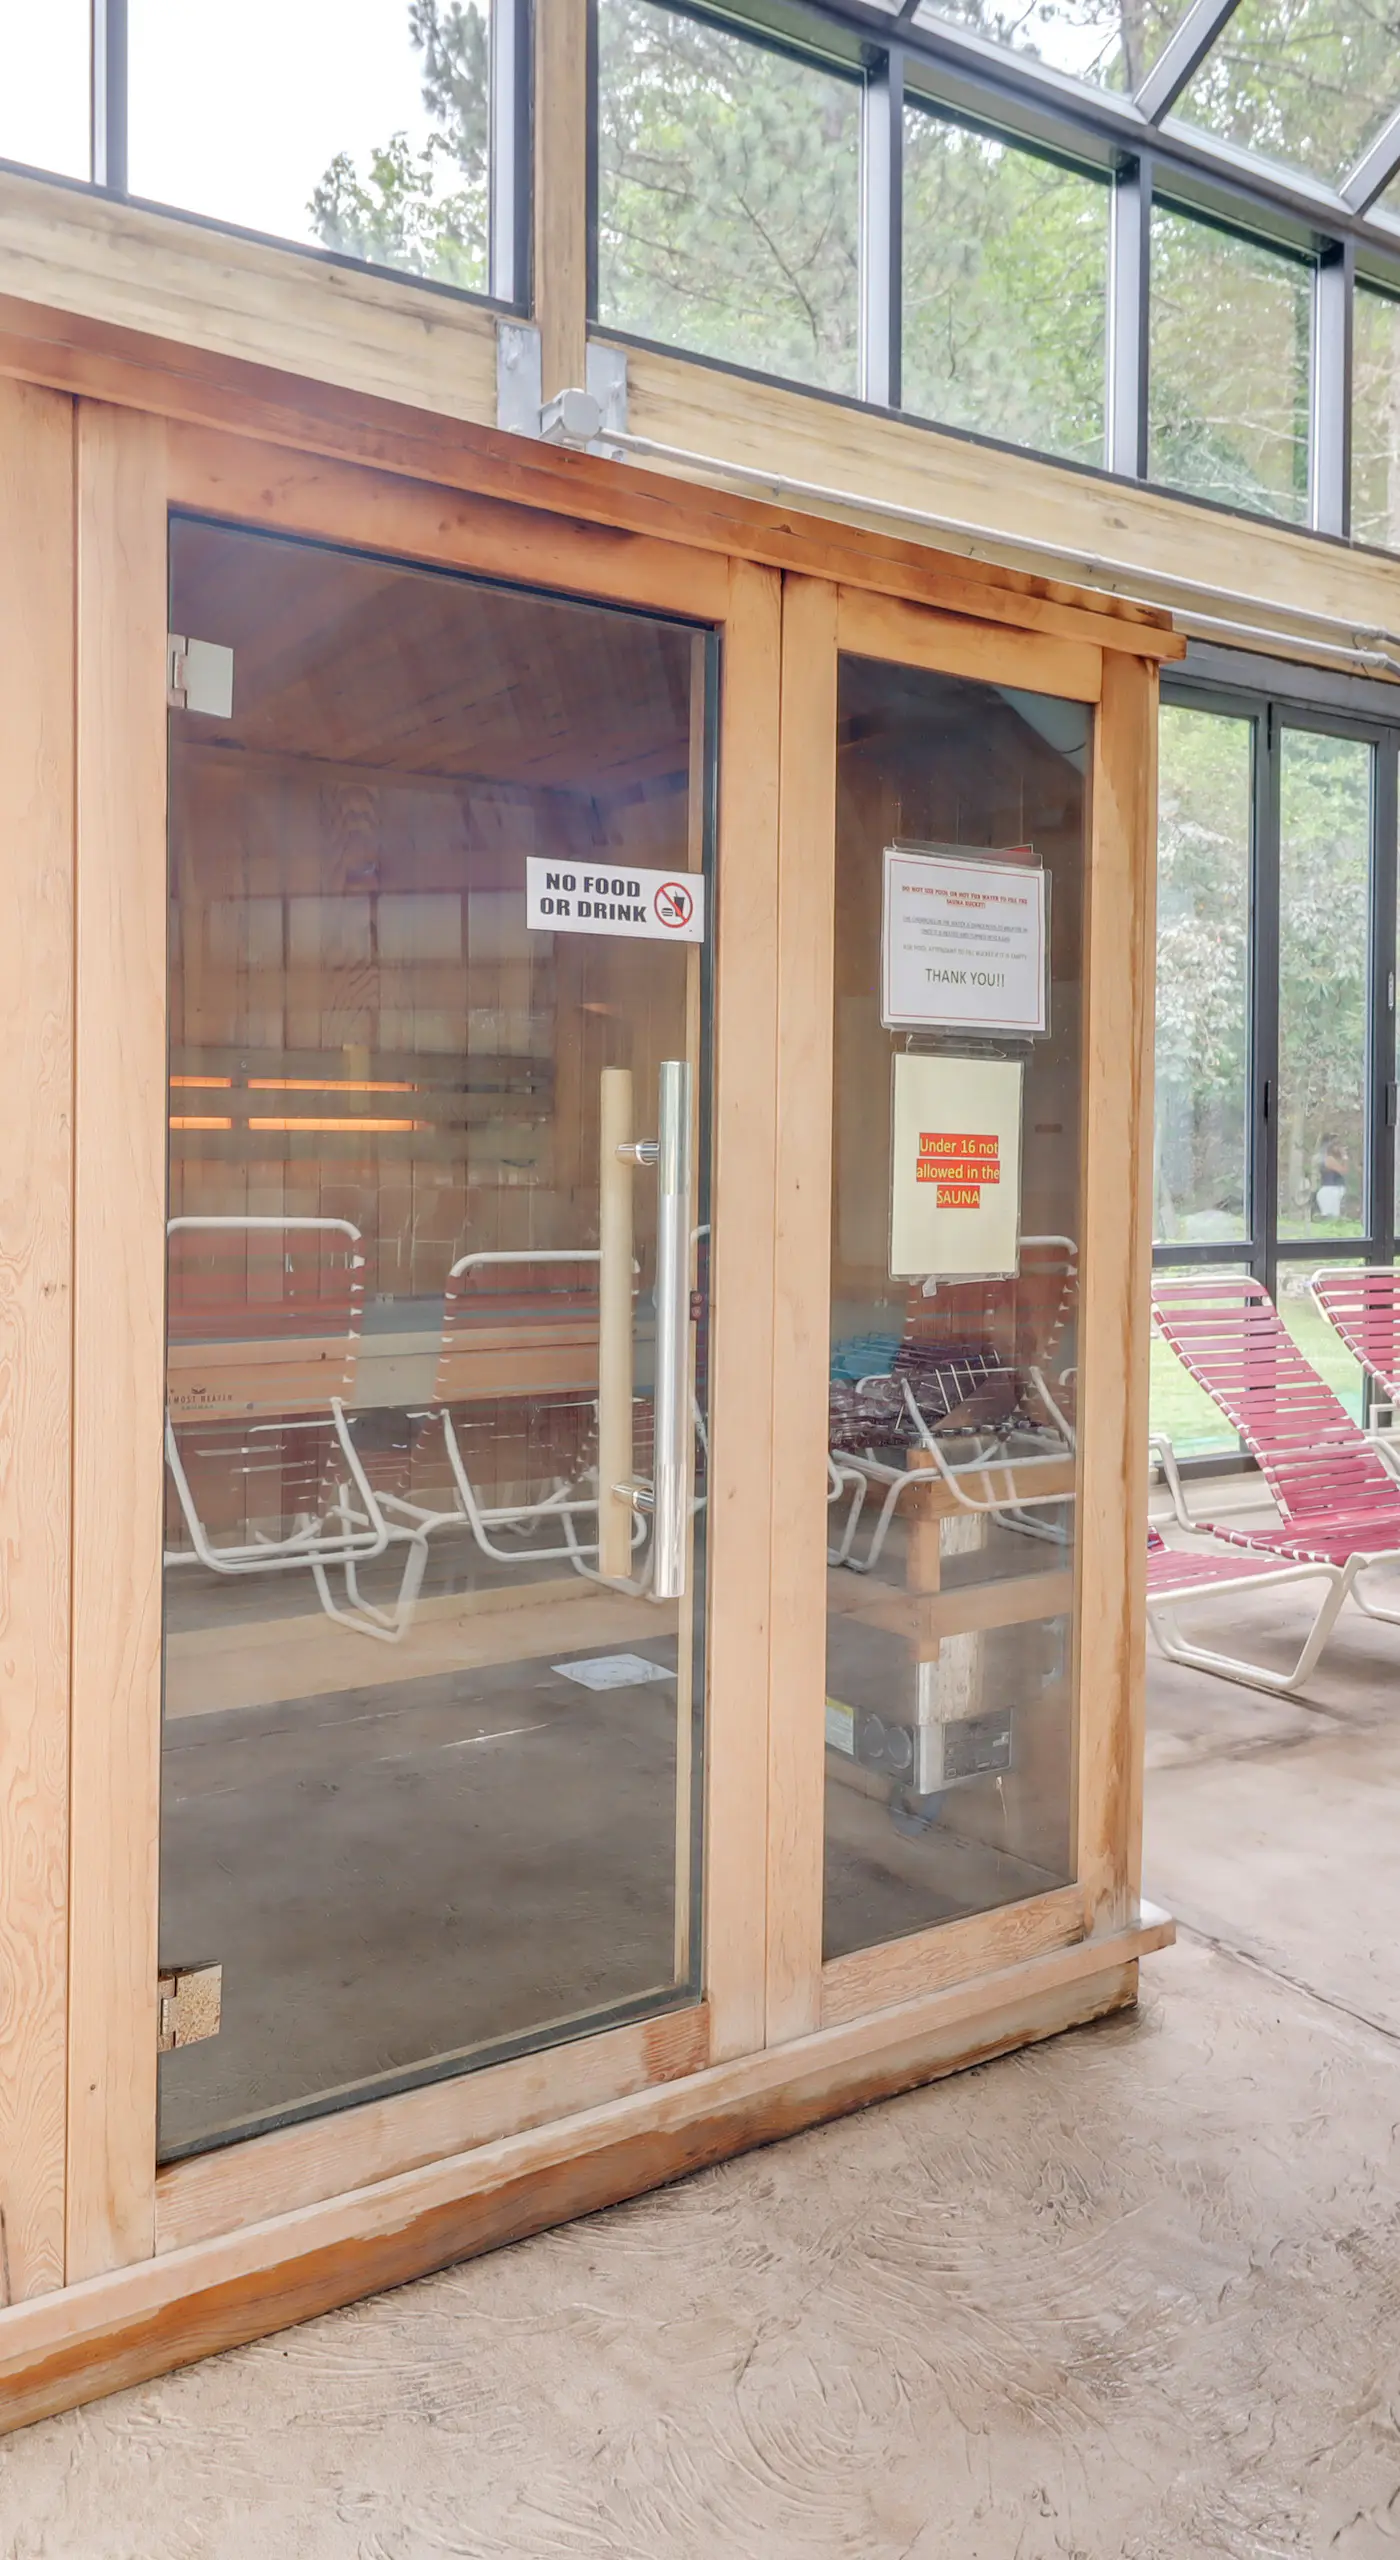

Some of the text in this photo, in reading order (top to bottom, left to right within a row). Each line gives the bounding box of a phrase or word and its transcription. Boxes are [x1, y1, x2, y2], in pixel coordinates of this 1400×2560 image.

[546, 872, 641, 898] NO FOOD
[540, 897, 647, 923] OR DRINK
[925, 968, 1005, 988] THANK YOU!!
[919, 1137, 999, 1155] Under 16 not
[916, 1163, 1000, 1180] allowed in the
[936, 1190, 981, 1204] SAUNA
